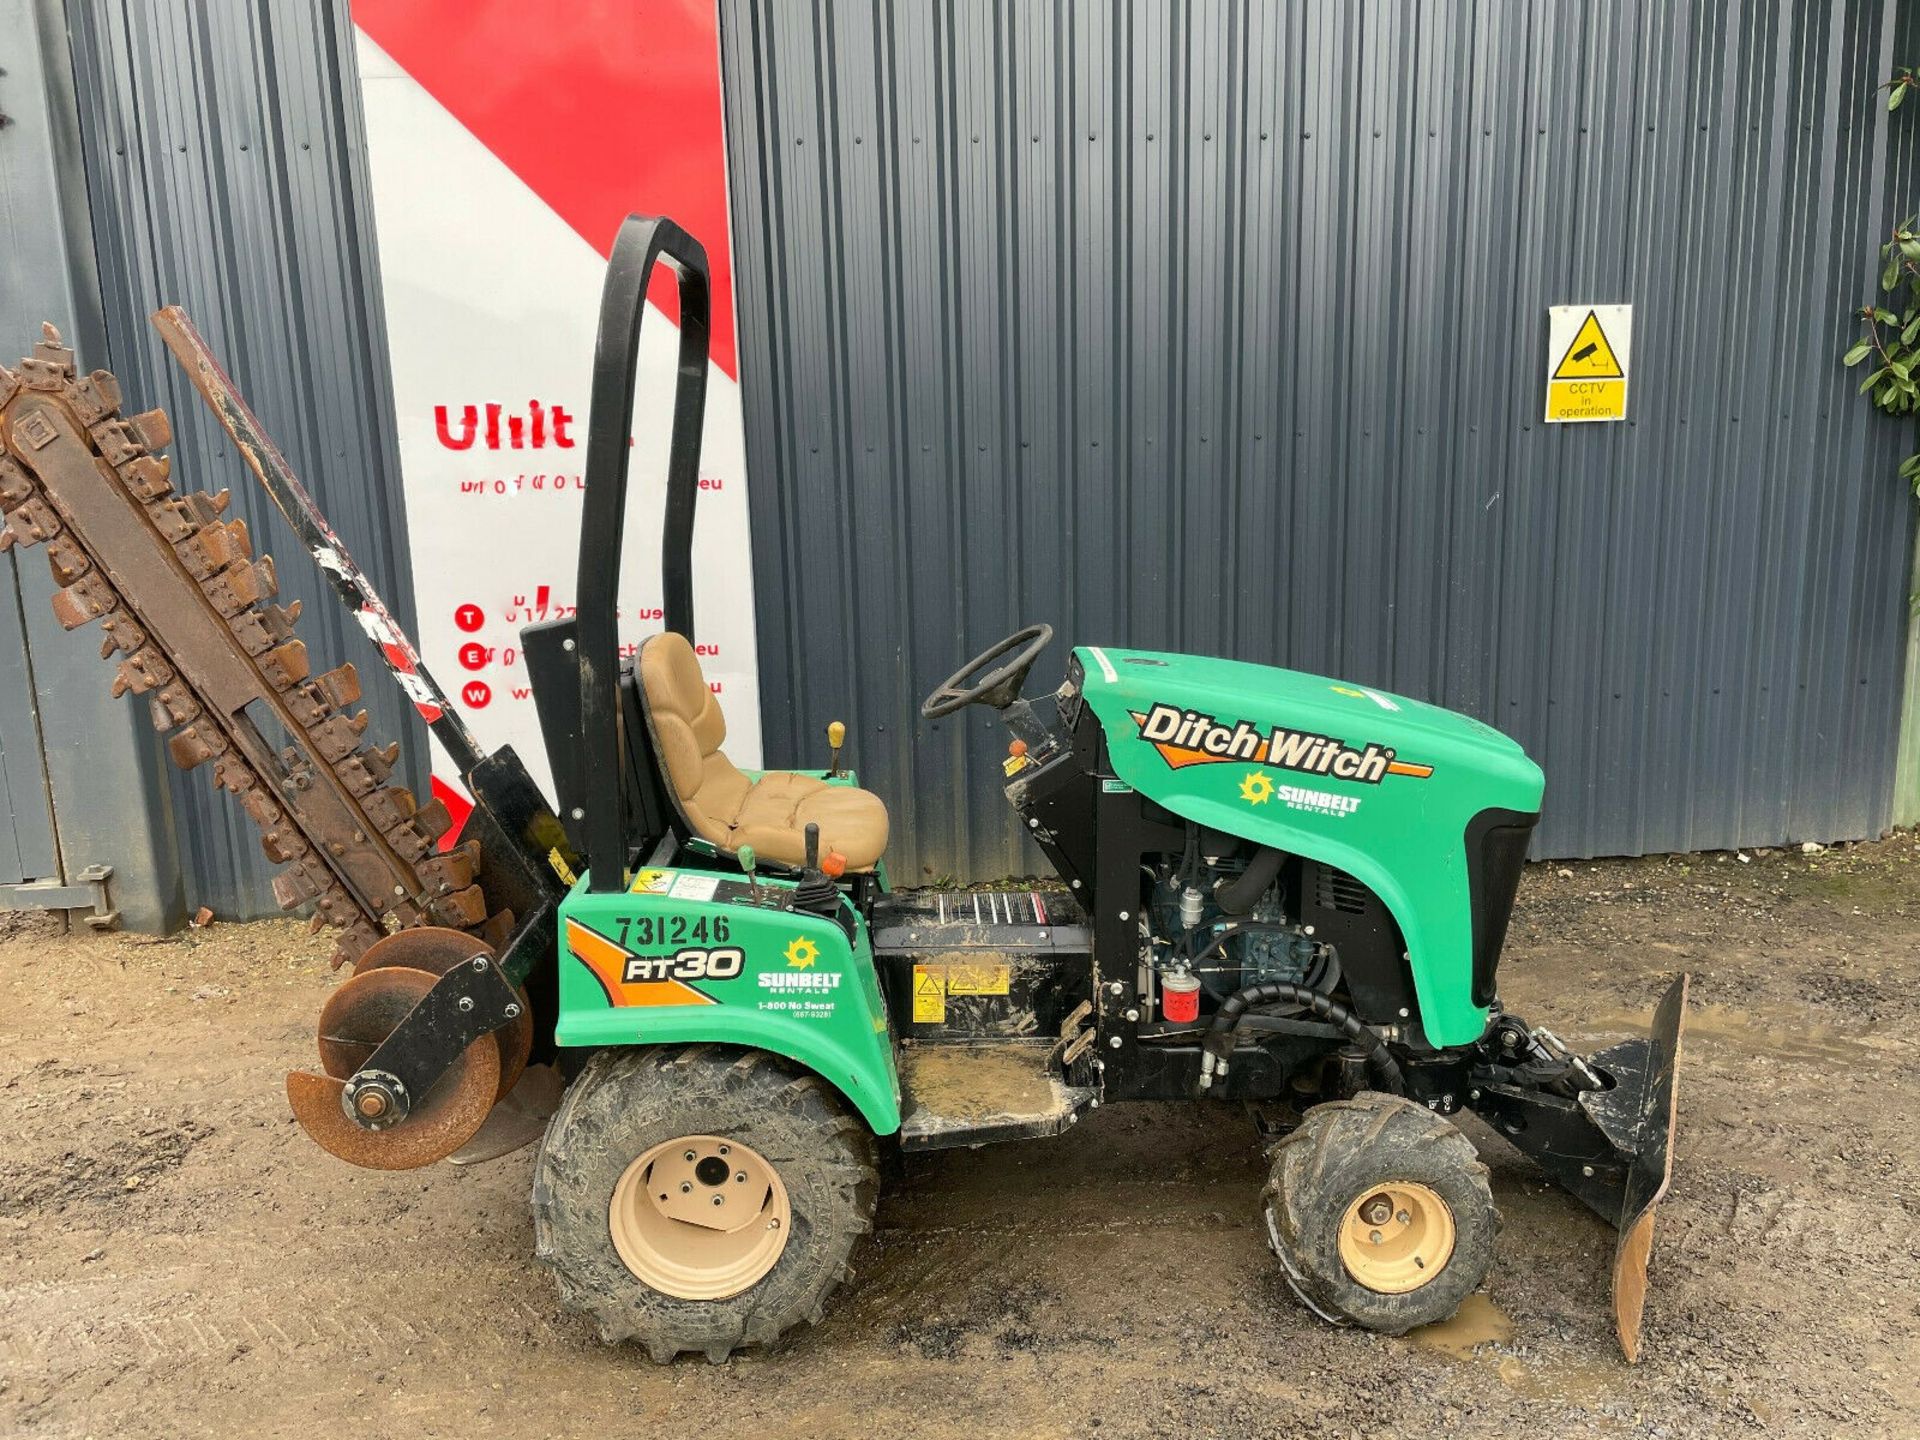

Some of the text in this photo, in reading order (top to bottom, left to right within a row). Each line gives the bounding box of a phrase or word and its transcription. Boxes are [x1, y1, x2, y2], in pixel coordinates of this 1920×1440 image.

[1569, 382, 1606, 394] CCTV
[1581, 396, 1591, 405] in
[1559, 406, 1611, 417] operation
[1143, 706, 1388, 781] Ditch Witch
[1277, 785, 1361, 813] SUNBELT
[1287, 802, 1346, 818] RENTALS
[616, 916, 729, 947] 731246
[626, 950, 741, 980] RT30
[758, 973, 842, 988] SUNBELT
[758, 1001, 835, 1010] 1-800 No Sweat
